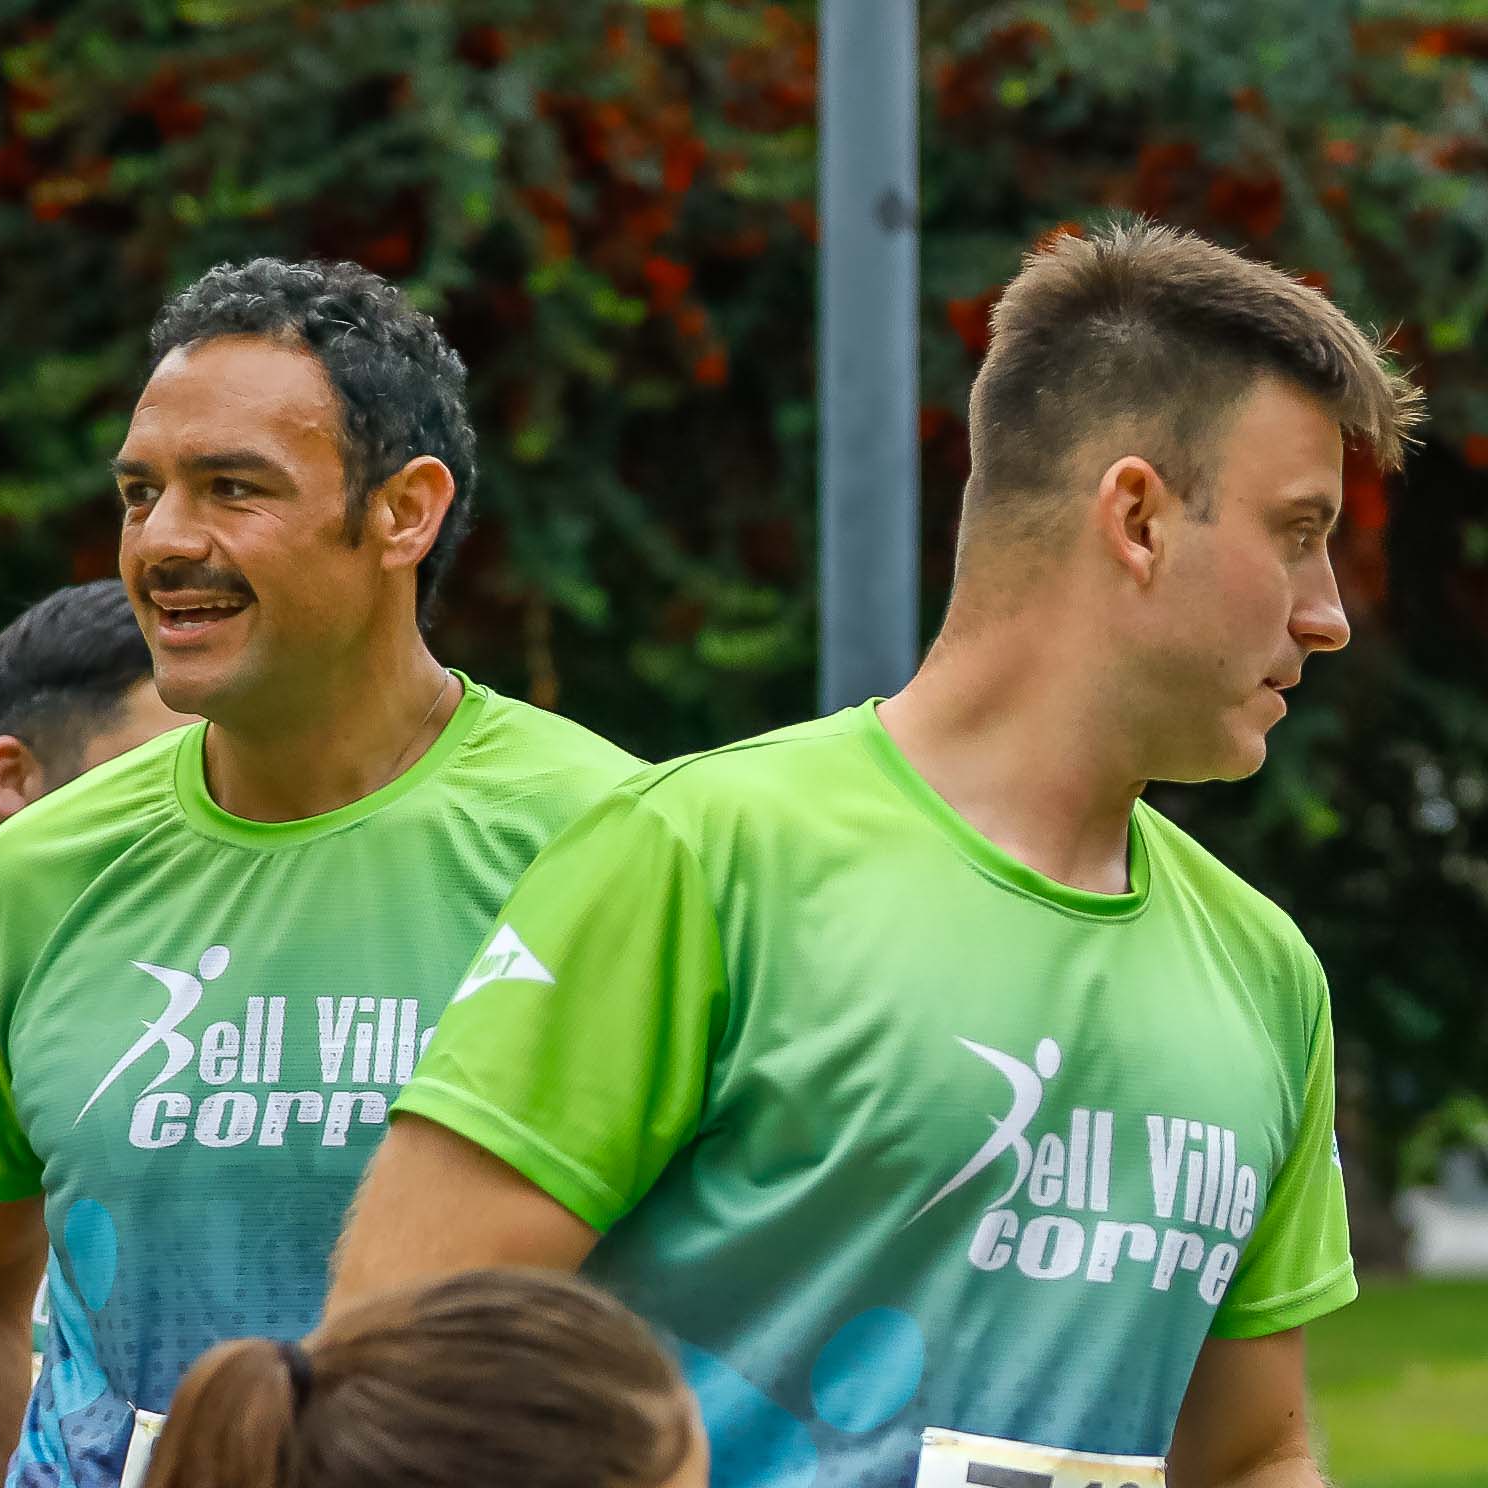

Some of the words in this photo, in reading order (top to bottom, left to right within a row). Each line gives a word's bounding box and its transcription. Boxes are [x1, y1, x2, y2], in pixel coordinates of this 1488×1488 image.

[316, 997, 438, 1084] Vill
[128, 1090, 389, 1149] corr
[1145, 1114, 1258, 1239] Ville
[968, 1209, 1240, 1305] corre
